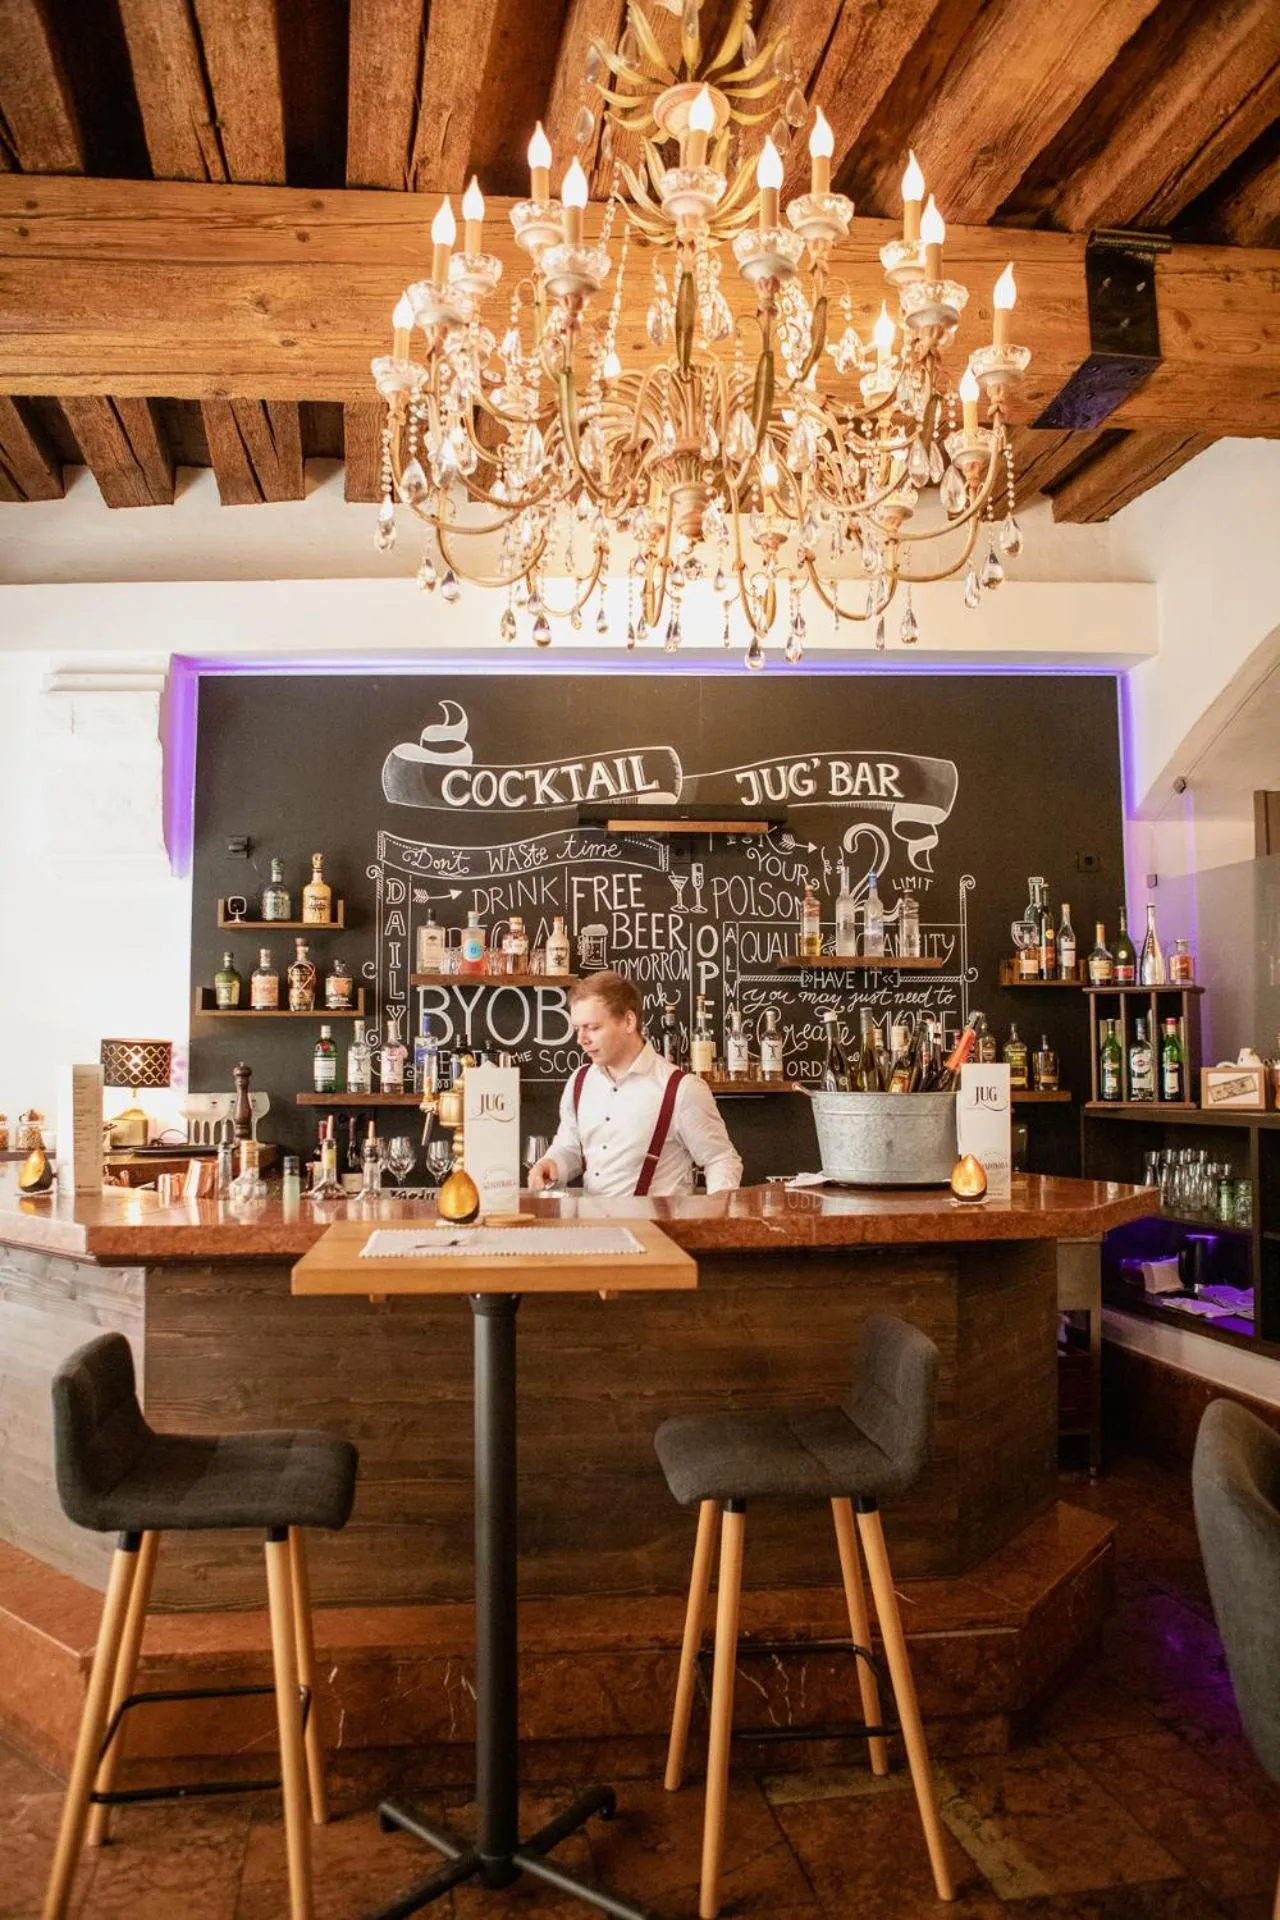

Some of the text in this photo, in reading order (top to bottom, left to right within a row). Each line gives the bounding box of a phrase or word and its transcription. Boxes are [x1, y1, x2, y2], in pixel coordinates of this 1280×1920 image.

[441, 755, 660, 807] COCKTAIL
[828, 762, 904, 798] BAR
[402, 848, 470, 877] Don't
[556, 834, 622, 860] time
[747, 847, 812, 889] YOUR
[472, 876, 559, 916] DRINK
[892, 876, 933, 892] LIMIT
[571, 873, 645, 936] FREE
[610, 912, 688, 951] BEER
[741, 930, 823, 964] QUALI
[385, 878, 406, 1040] DAILY
[610, 950, 691, 982] TOMORROW
[696, 925, 720, 1045] OPE
[814, 971, 882, 989] HAVE IT
[416, 985, 575, 1047] BYOB
[742, 986, 956, 1016] you may just need to
[511, 1050, 533, 1065] THE
[539, 1049, 588, 1074] SCO
[476, 1093, 505, 1117] JUG
[976, 1086, 998, 1106] JUG
